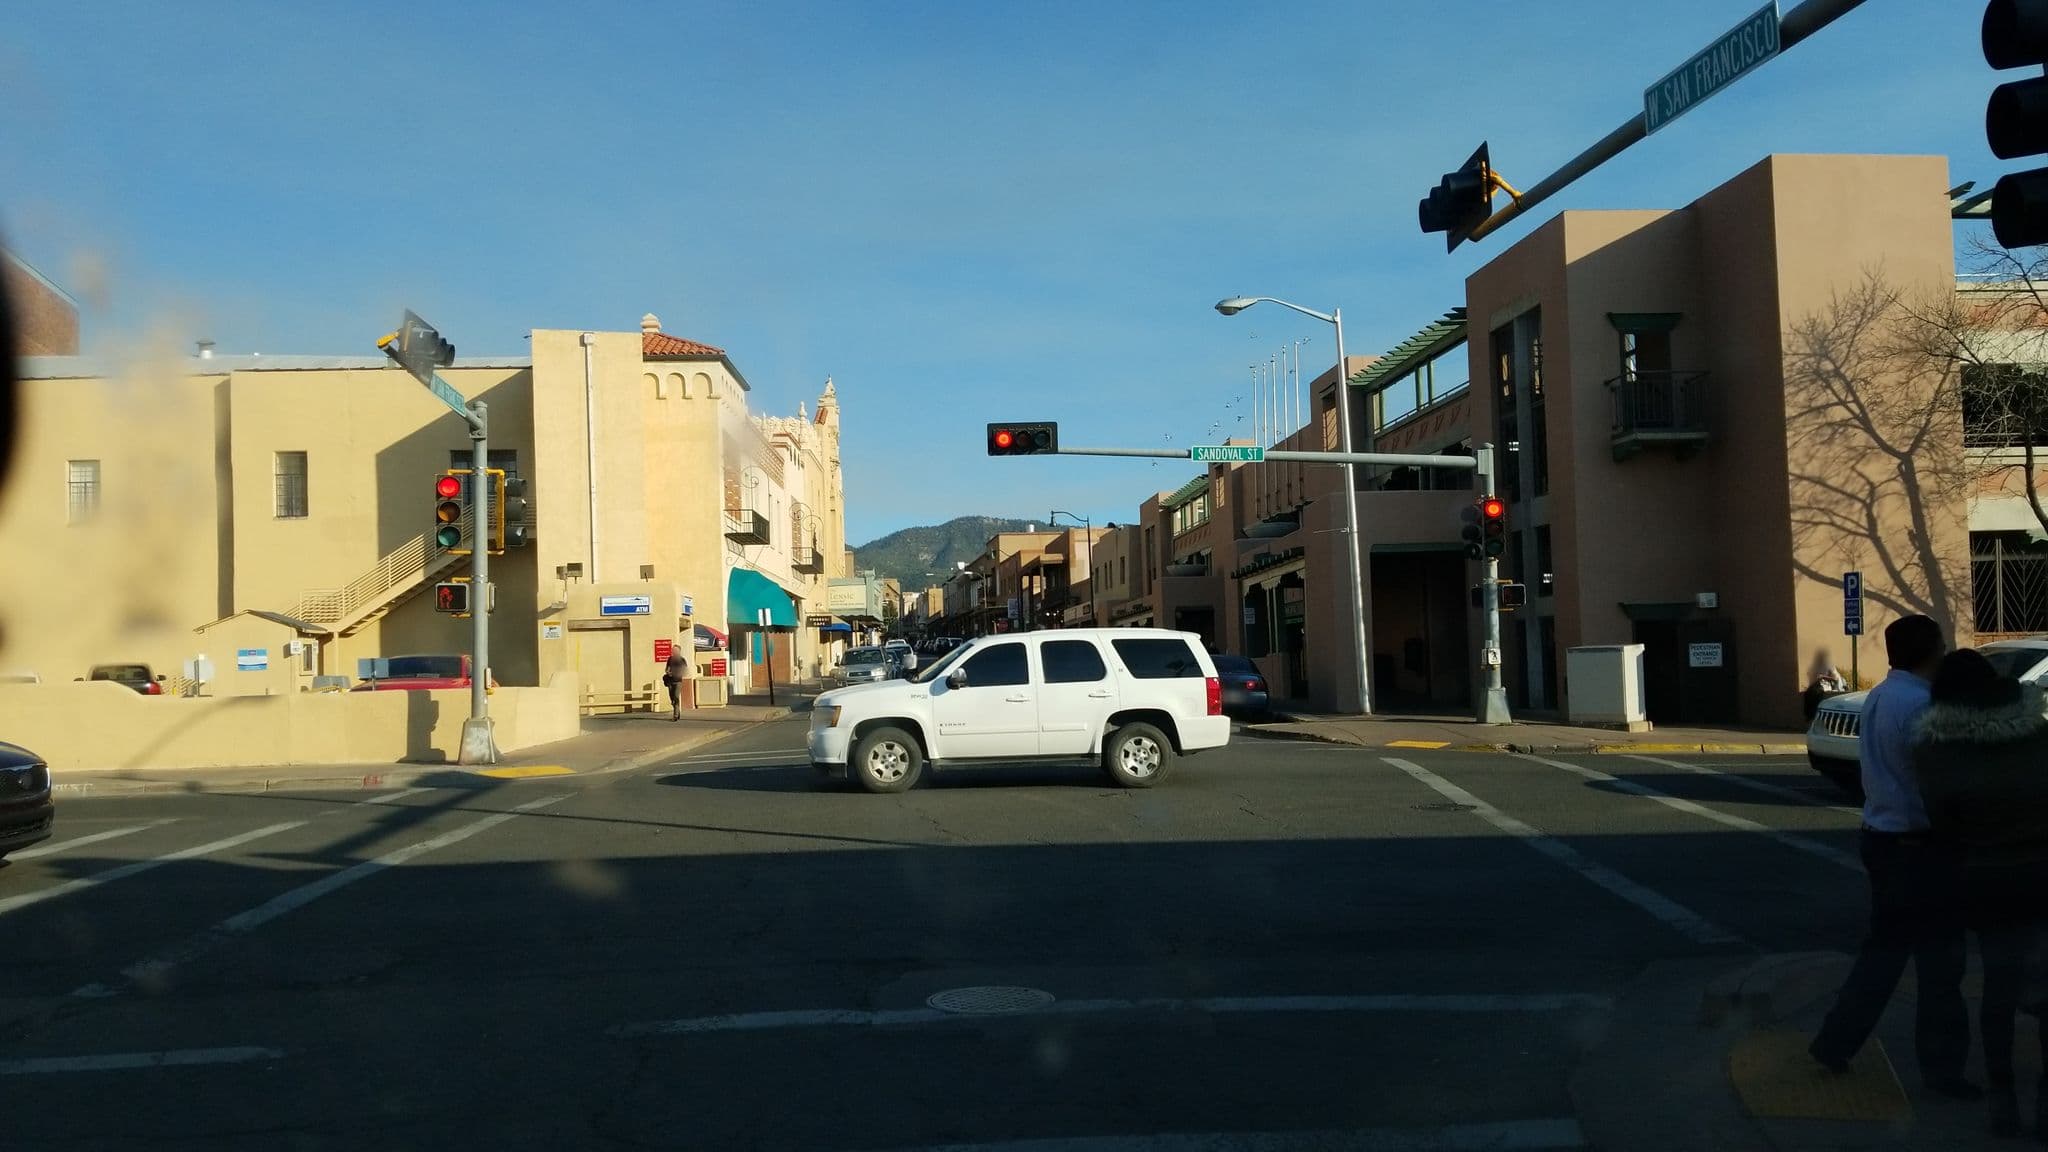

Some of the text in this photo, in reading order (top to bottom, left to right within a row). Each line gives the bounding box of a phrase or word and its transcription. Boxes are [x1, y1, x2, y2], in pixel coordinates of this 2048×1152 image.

[1648, 11, 1775, 127] W SAN FRANCISCO
[1198, 447, 1258, 460] SANDOVAL ST
[1847, 575, 1858, 596] P
